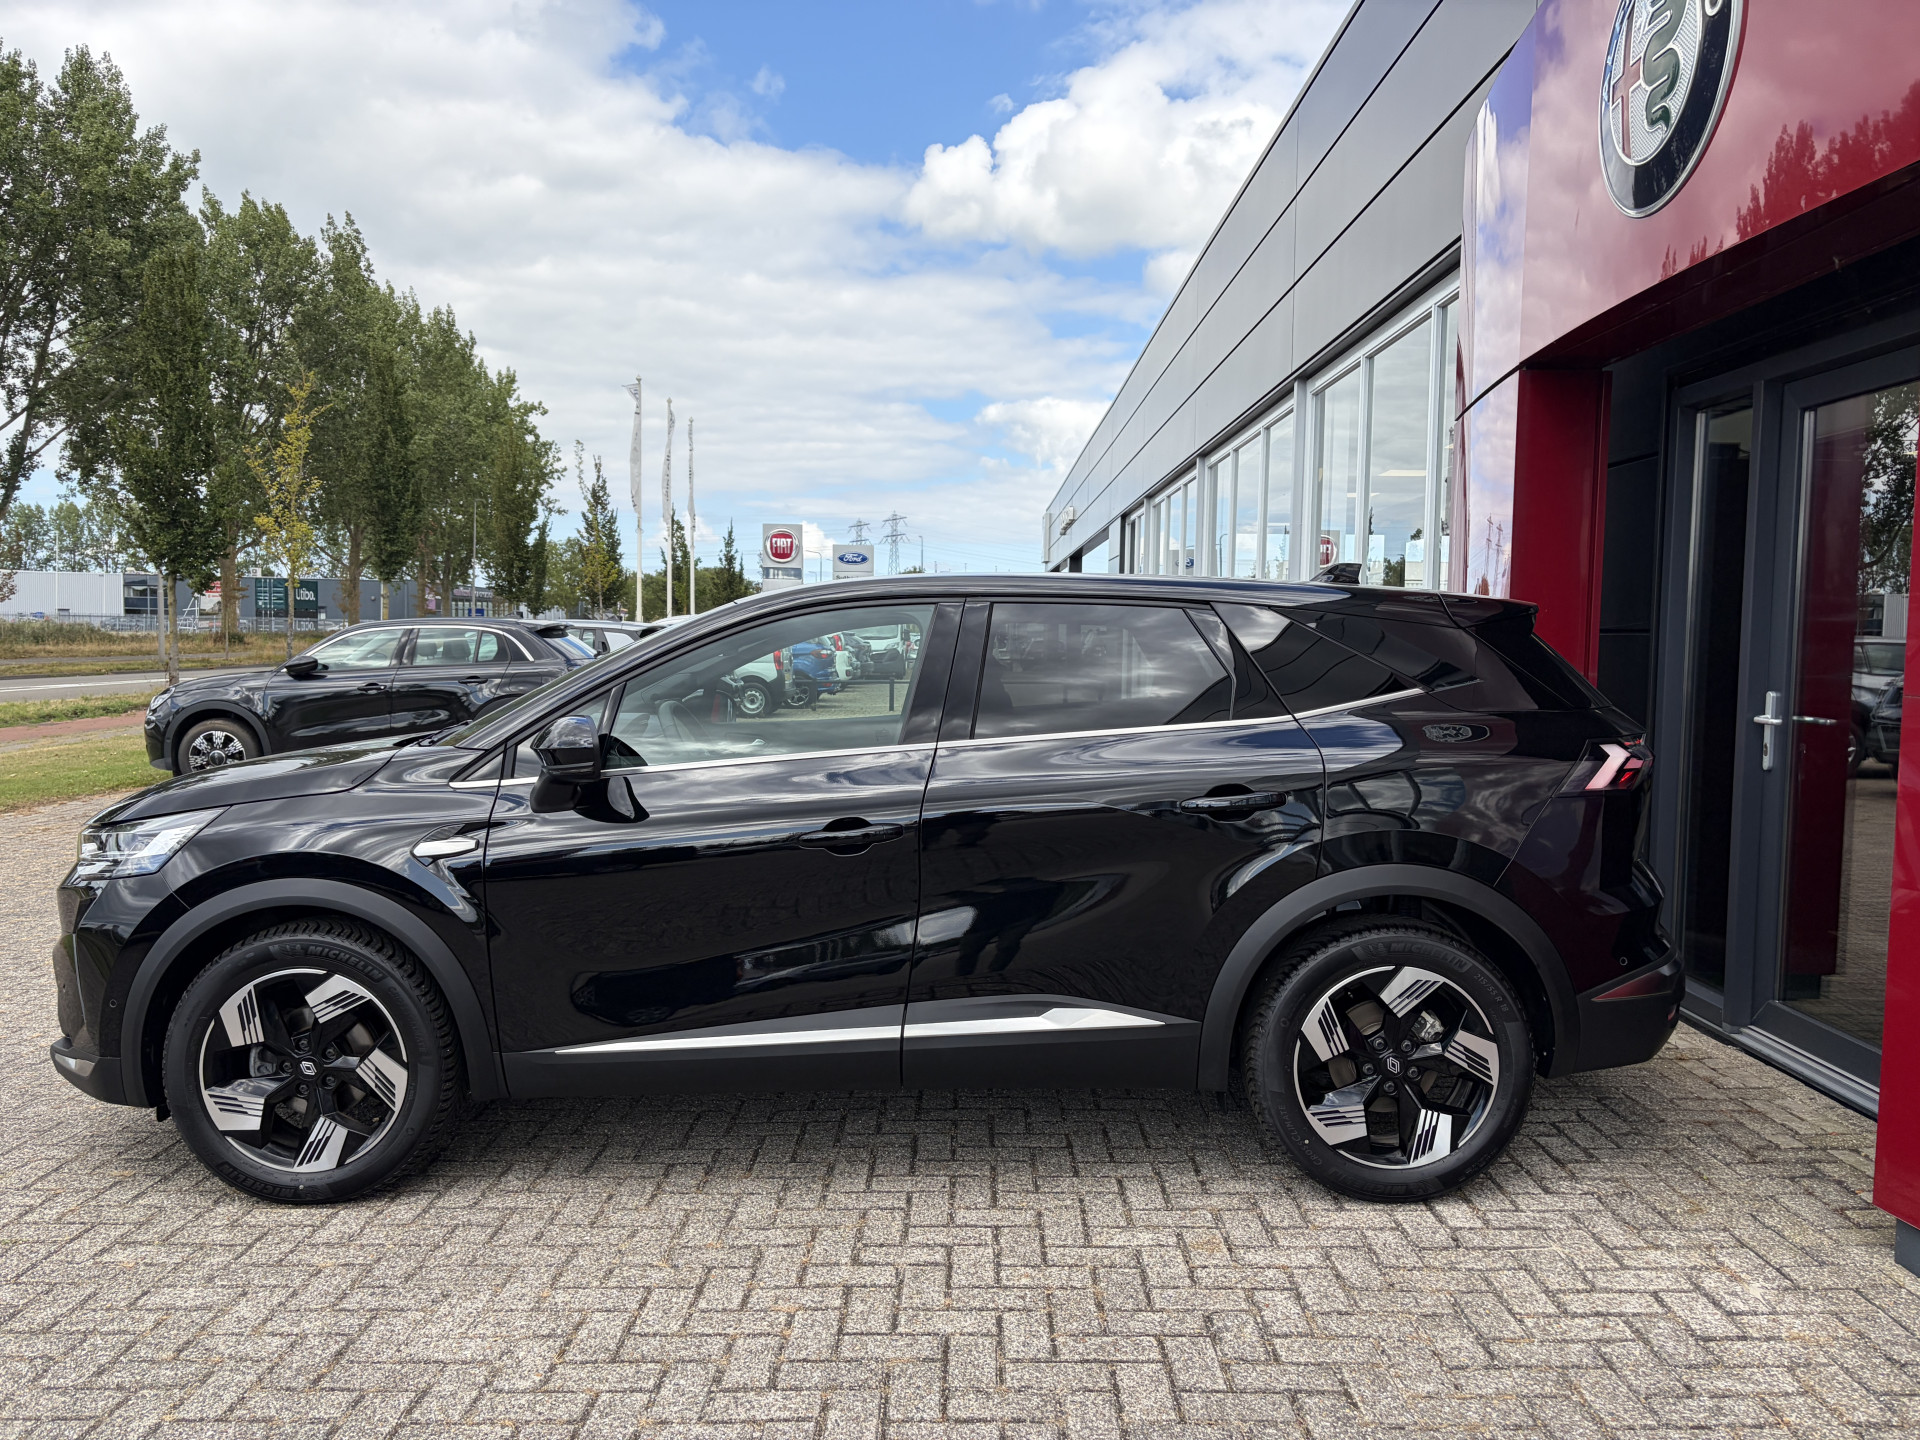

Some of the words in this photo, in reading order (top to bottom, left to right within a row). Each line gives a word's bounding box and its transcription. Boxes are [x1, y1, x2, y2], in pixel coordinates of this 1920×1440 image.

[772, 538, 792, 553] FIAT
[843, 553, 863, 562] Ford
[306, 945, 383, 981] MICHELIN
[1473, 973, 1497, 996] 215/55
[1500, 1003, 1510, 1013] 18
[217, 1162, 298, 1199] MICHELIN
